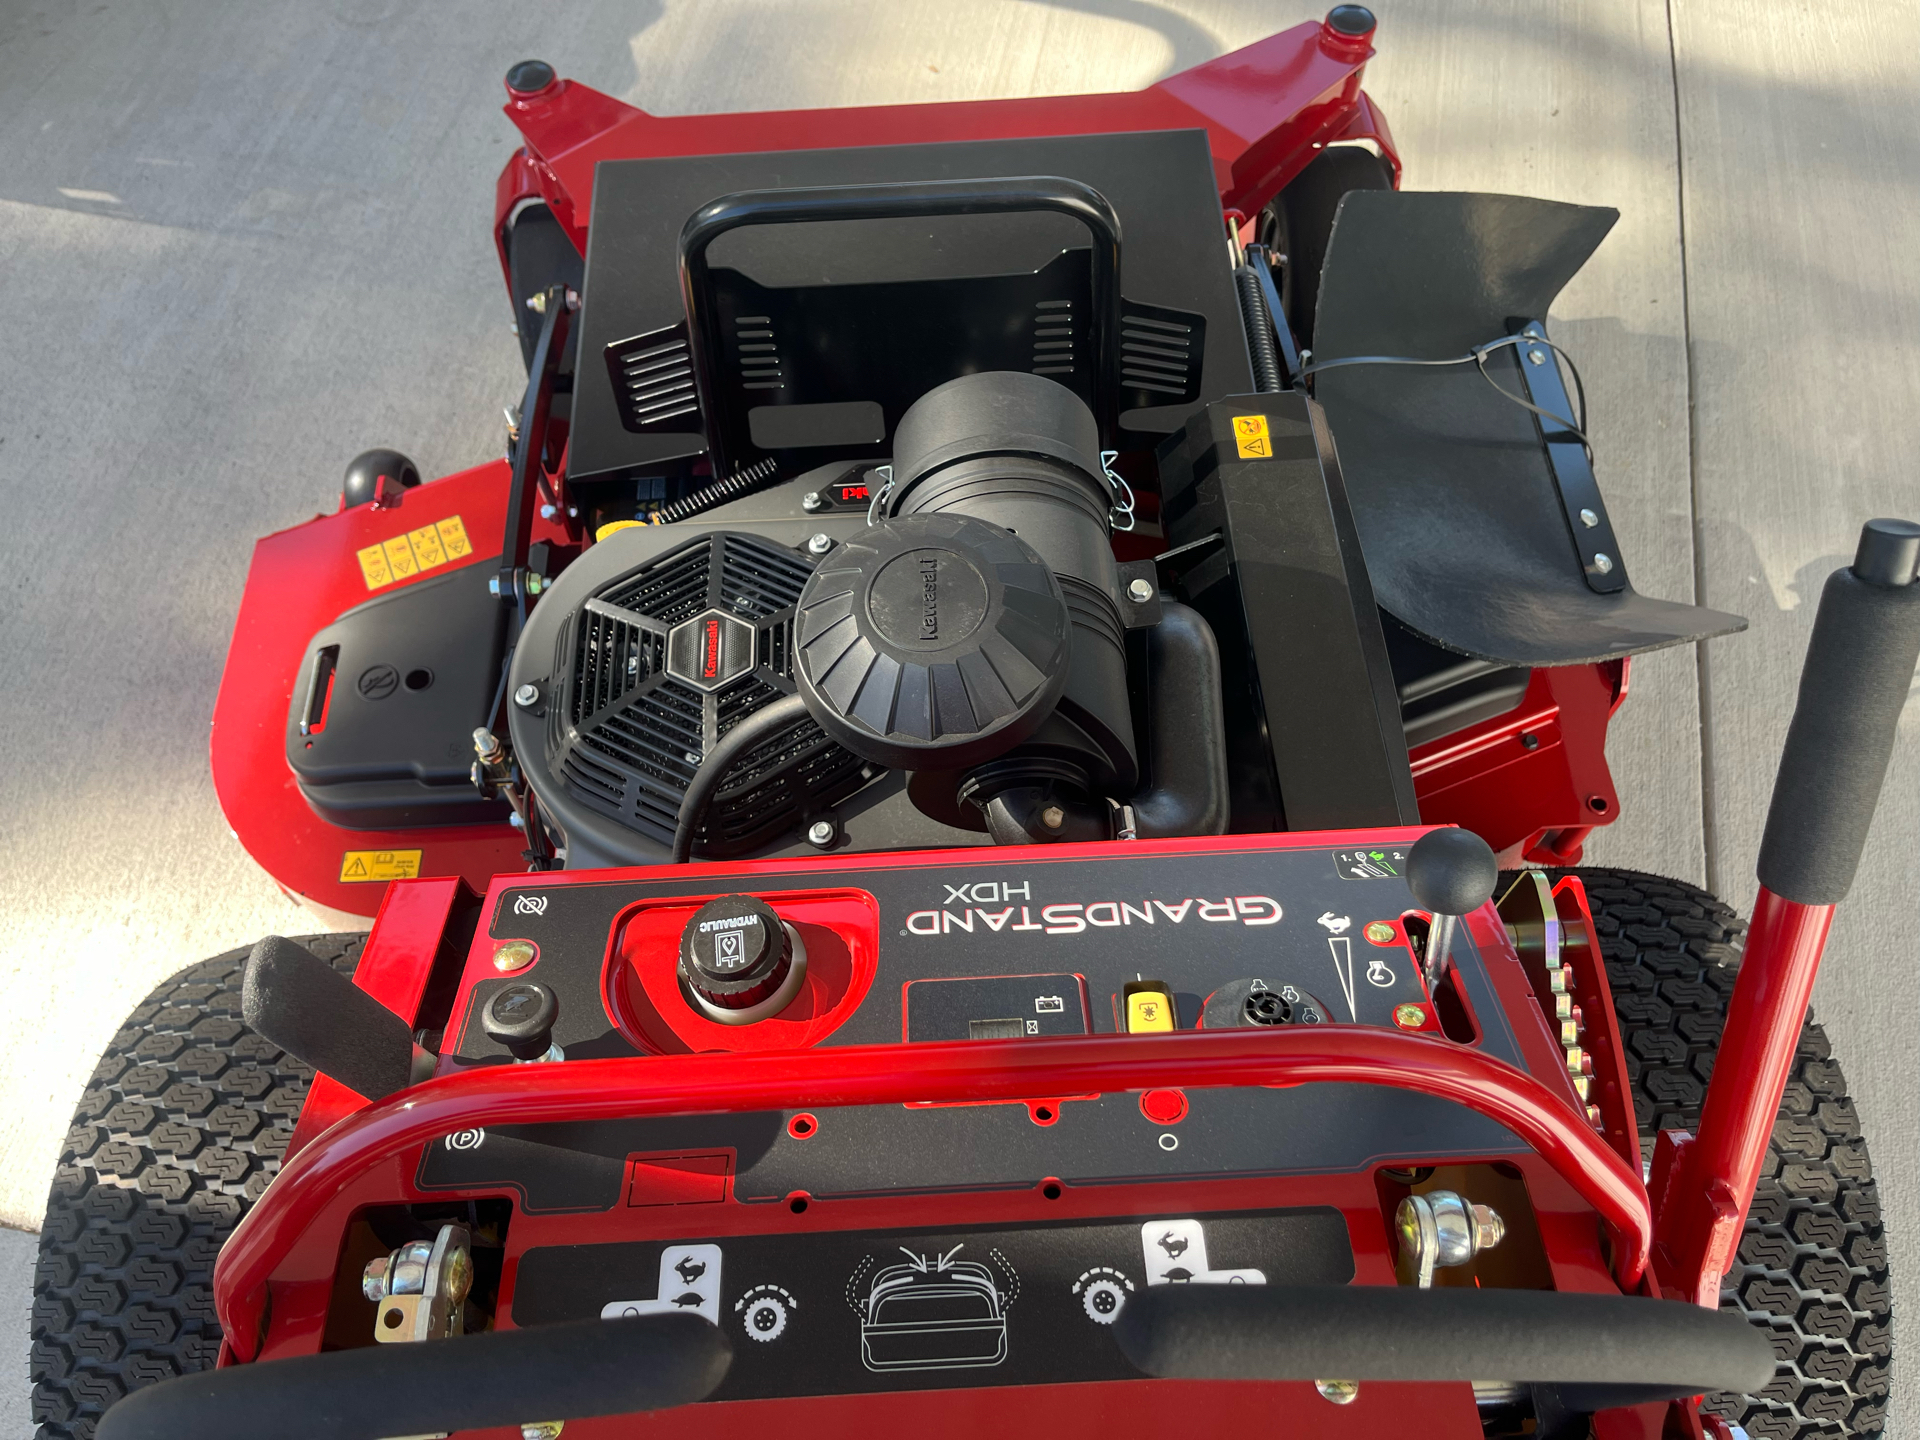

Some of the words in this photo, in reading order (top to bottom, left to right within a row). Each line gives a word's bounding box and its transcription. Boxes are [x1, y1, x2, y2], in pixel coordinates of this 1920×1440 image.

[919, 558, 938, 640] Kawasaki
[704, 620, 718, 678] Kawasaki
[1340, 853, 1352, 862] 1.
[1392, 851, 1405, 860] 2.
[942, 880, 1030, 904] HDX
[699, 914, 758, 933] HYDRAULIC
